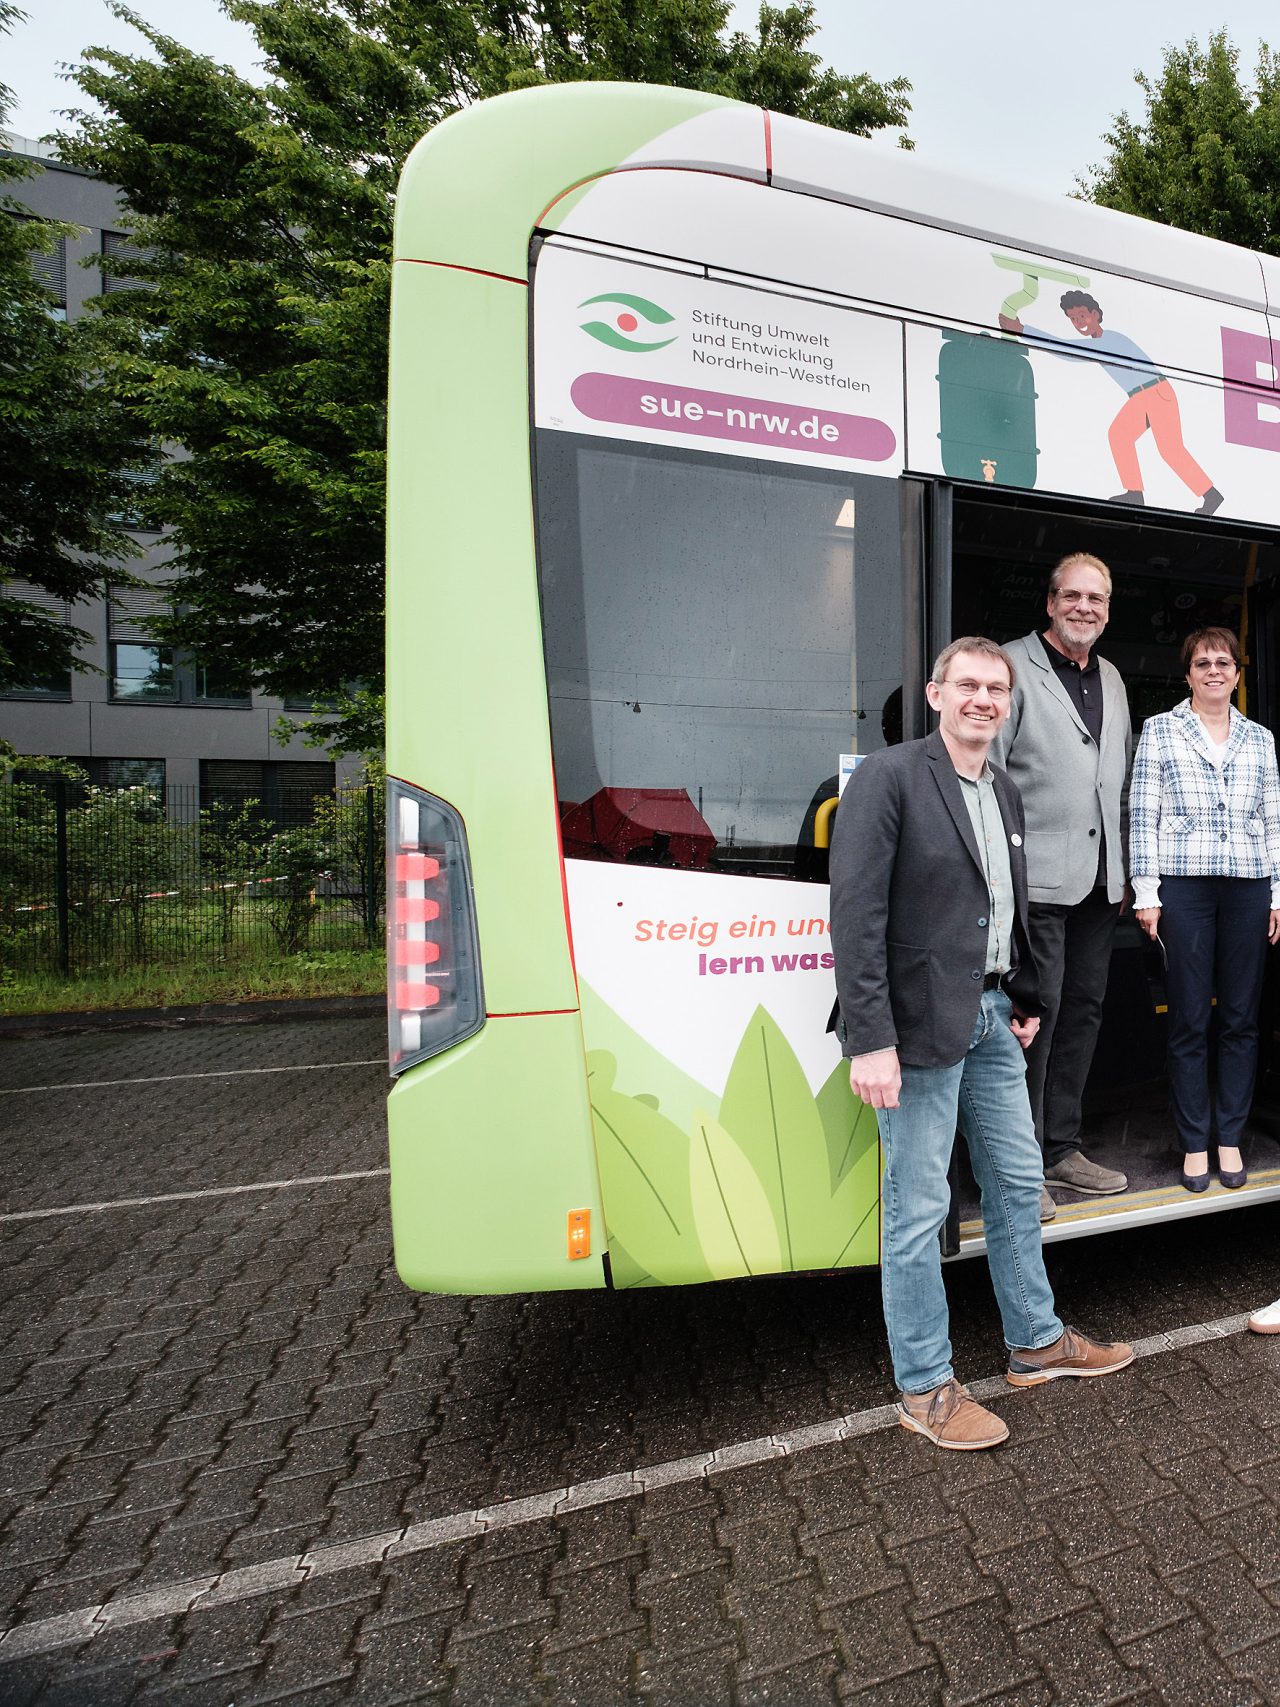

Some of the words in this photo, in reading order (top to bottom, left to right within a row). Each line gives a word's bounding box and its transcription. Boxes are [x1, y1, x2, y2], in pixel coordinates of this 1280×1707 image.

[691, 309, 763, 338] Stiftung
[767, 324, 830, 348] Umwelt
[692, 332, 726, 348] und
[731, 337, 834, 370] Entwicklung
[692, 349, 871, 393] Nordrhein-Westfalen
[639, 394, 840, 442] sue-nrw.de
[634, 915, 719, 947] Steig
[728, 914, 776, 938] ein
[787, 918, 830, 936] un
[698, 953, 765, 976] lern
